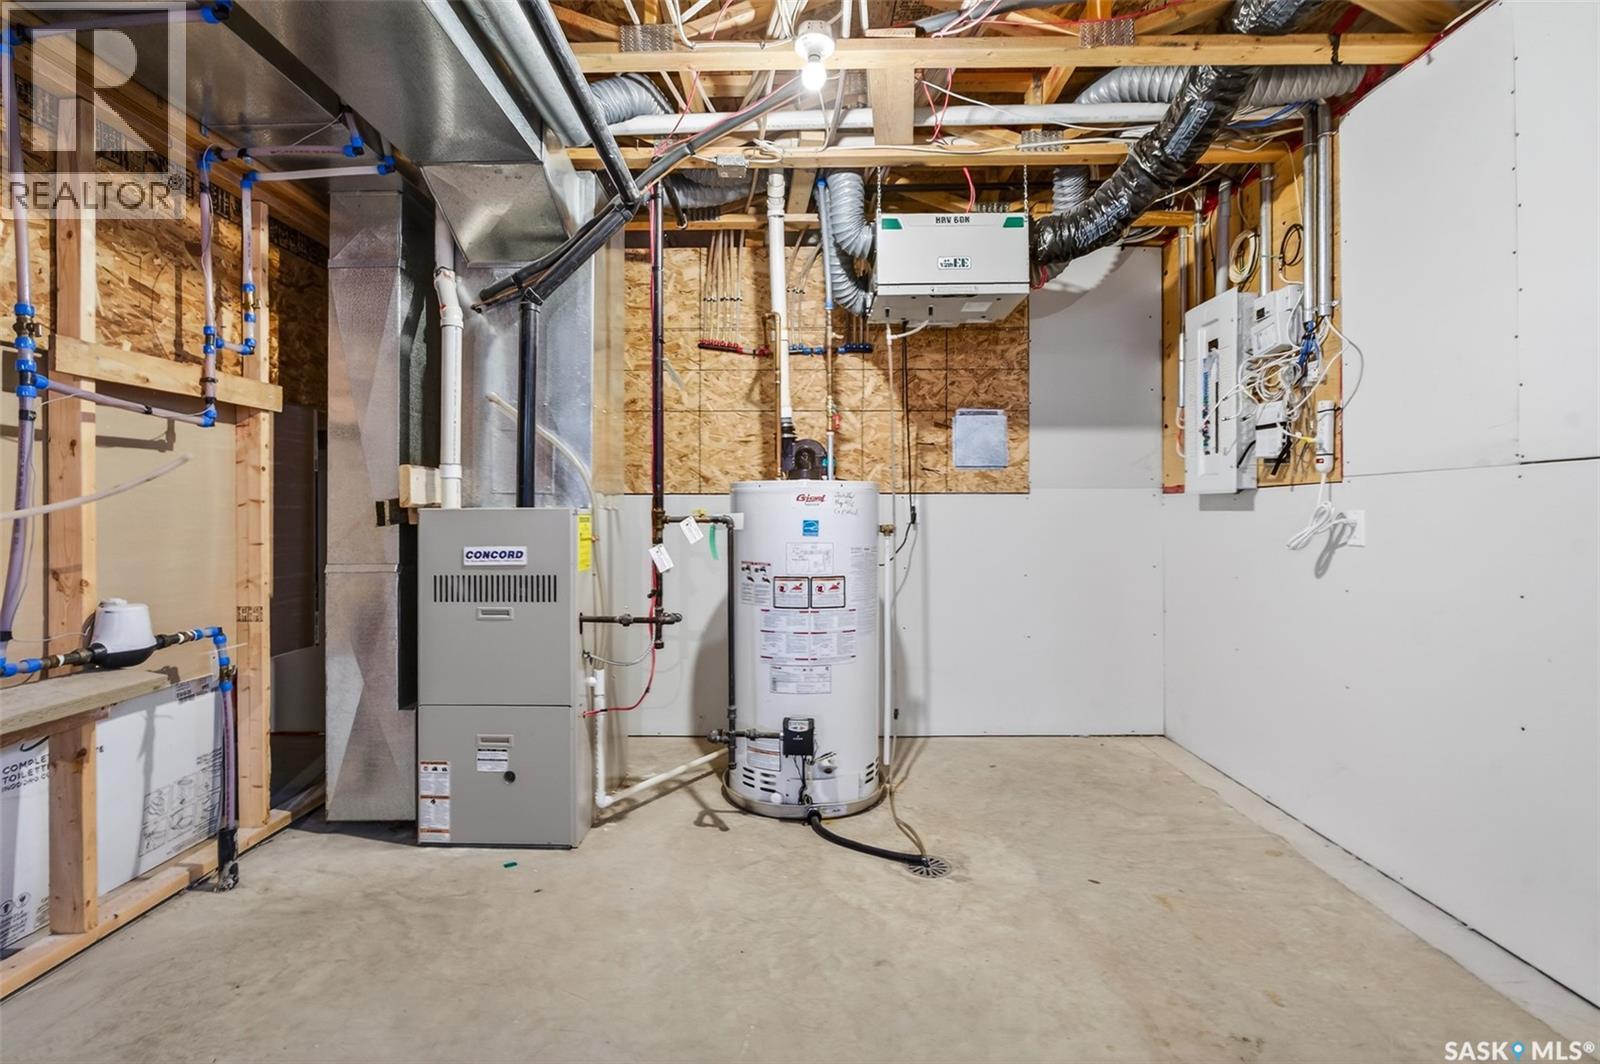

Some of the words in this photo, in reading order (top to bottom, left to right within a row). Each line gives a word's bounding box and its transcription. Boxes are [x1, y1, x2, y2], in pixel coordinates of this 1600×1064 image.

[935, 216, 951, 224] HRV
[796, 493, 827, 503] Giant
[465, 550, 524, 560] CONCORD
[2, 754, 48, 775] COMPLE
